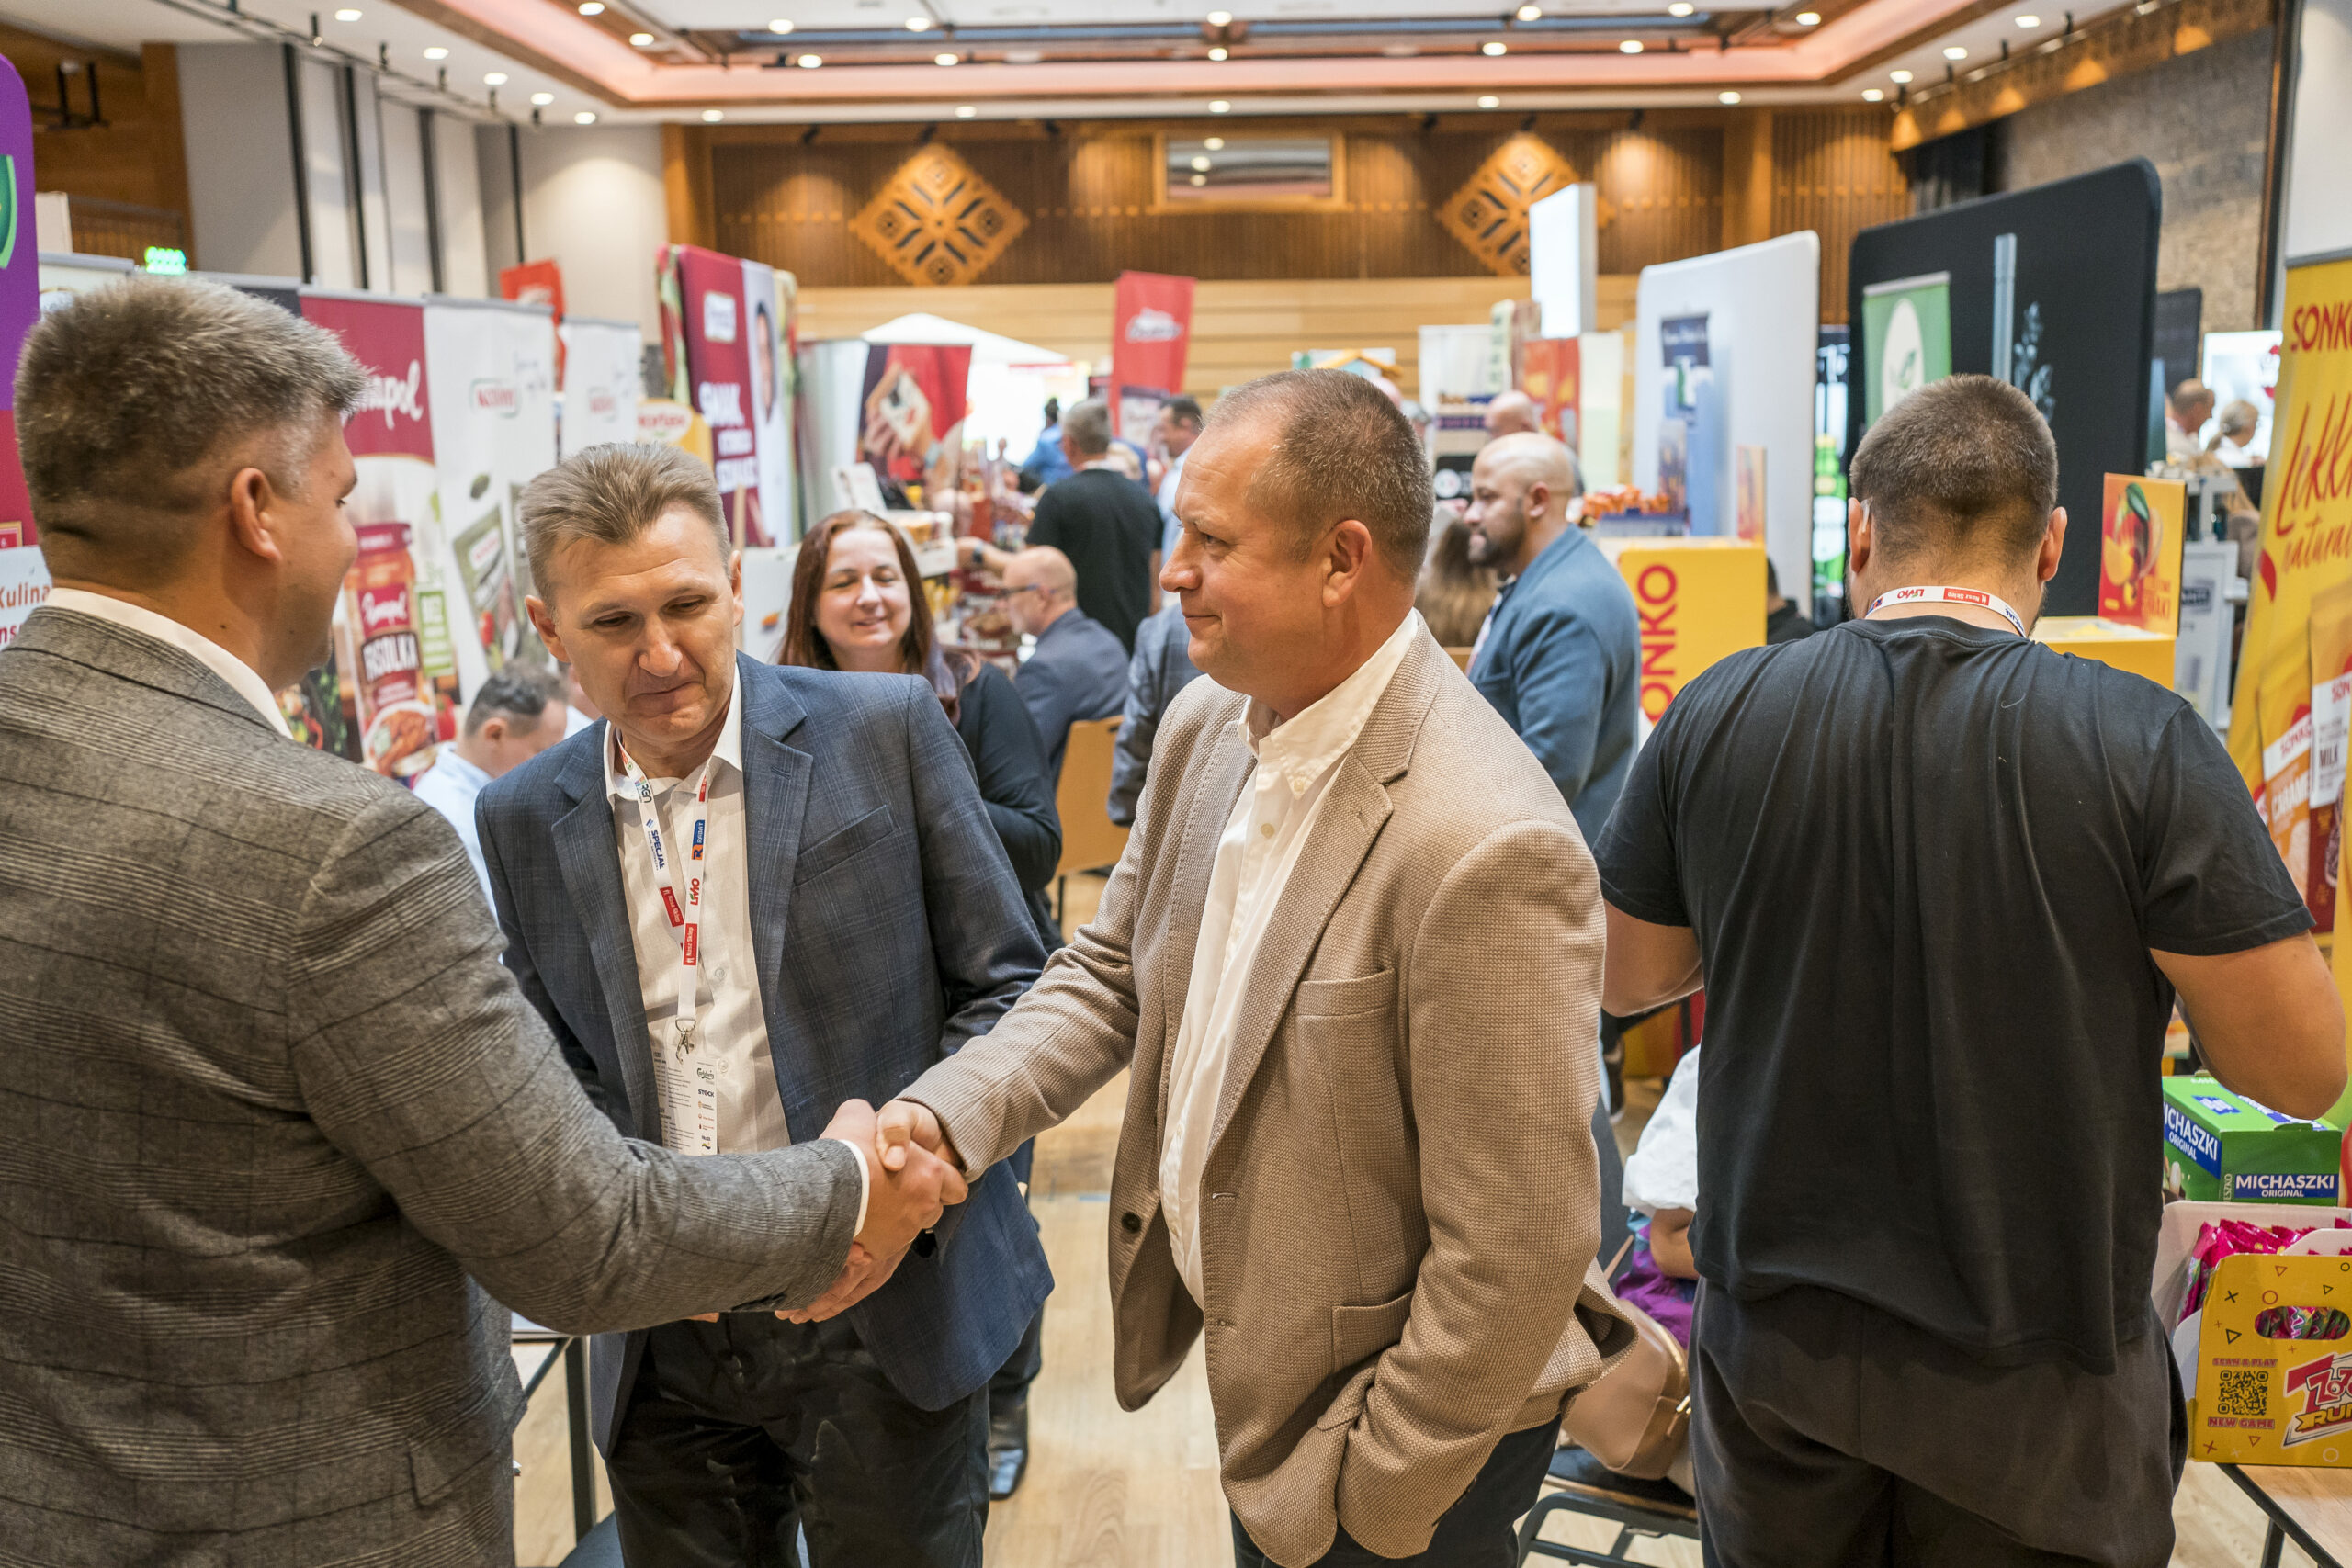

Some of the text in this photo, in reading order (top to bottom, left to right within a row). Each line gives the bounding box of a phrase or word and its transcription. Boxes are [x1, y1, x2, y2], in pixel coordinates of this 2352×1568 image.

[2290, 302, 2352, 352] SONK
[2276, 391, 2352, 537] Lekk
[1636, 564, 1678, 721] ONKO
[2164, 1102, 2219, 1161] ICHASZKI
[2234, 1175, 2335, 1190] MICHASZKI
[2261, 1189, 2304, 1198] ORIGINAL
[2212, 1357, 2240, 1366] SCAN
[2251, 1359, 2278, 1368] PLAY
[2208, 1417, 2276, 1429] NEW GAME
